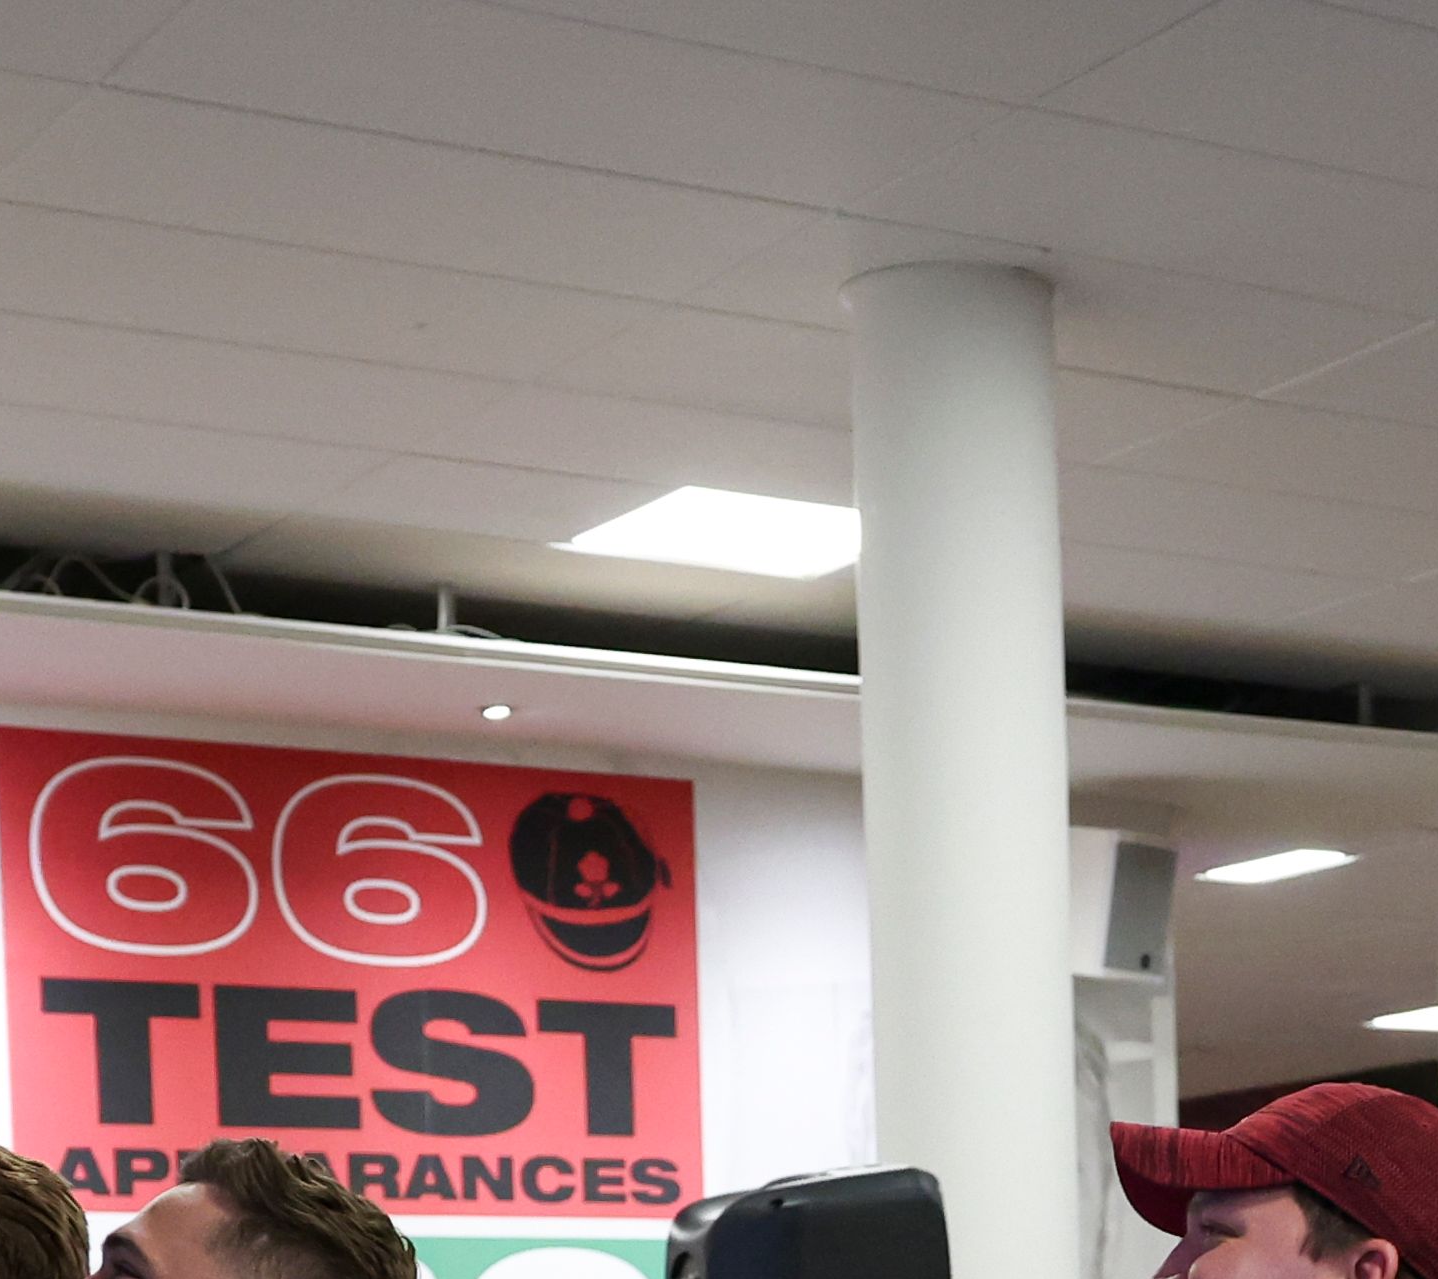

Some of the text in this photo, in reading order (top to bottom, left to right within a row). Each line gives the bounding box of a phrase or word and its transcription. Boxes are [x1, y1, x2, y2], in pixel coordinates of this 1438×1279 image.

[27, 753, 488, 967] 66
[40, 976, 676, 1137] TEST
[57, 1146, 682, 1206] APRANCES
